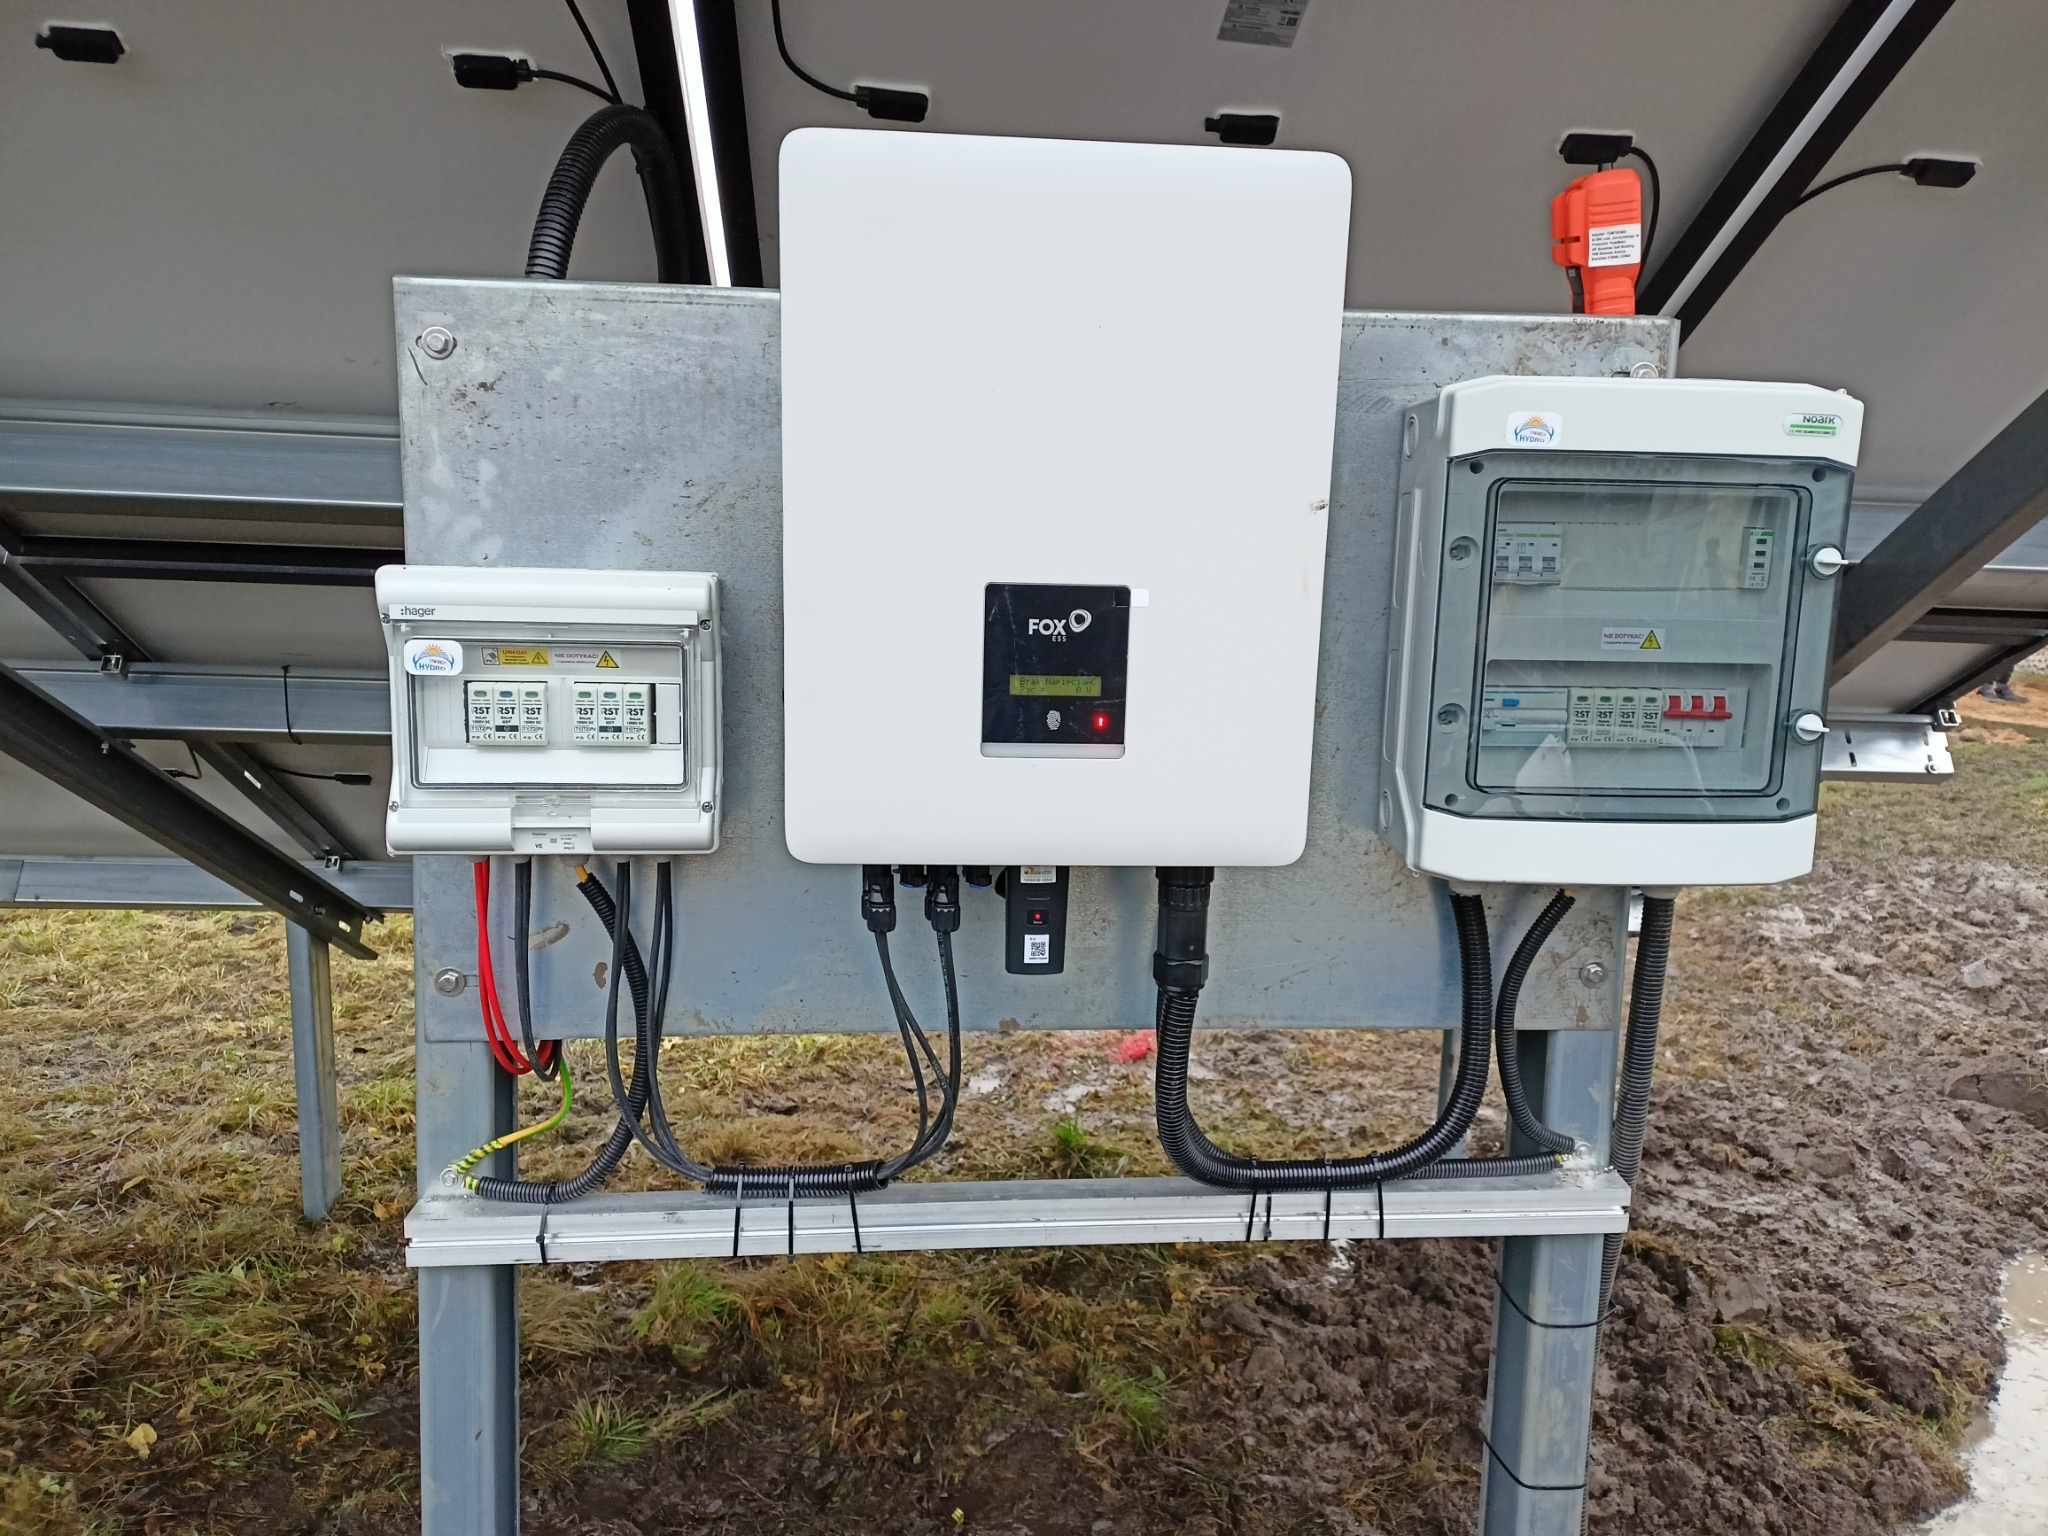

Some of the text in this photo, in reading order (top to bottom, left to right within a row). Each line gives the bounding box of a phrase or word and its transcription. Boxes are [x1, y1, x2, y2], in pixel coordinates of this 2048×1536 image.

[1028, 619, 1067, 635] FOX
[419, 663, 446, 671] HYDRO
[626, 708, 644, 716] RST
